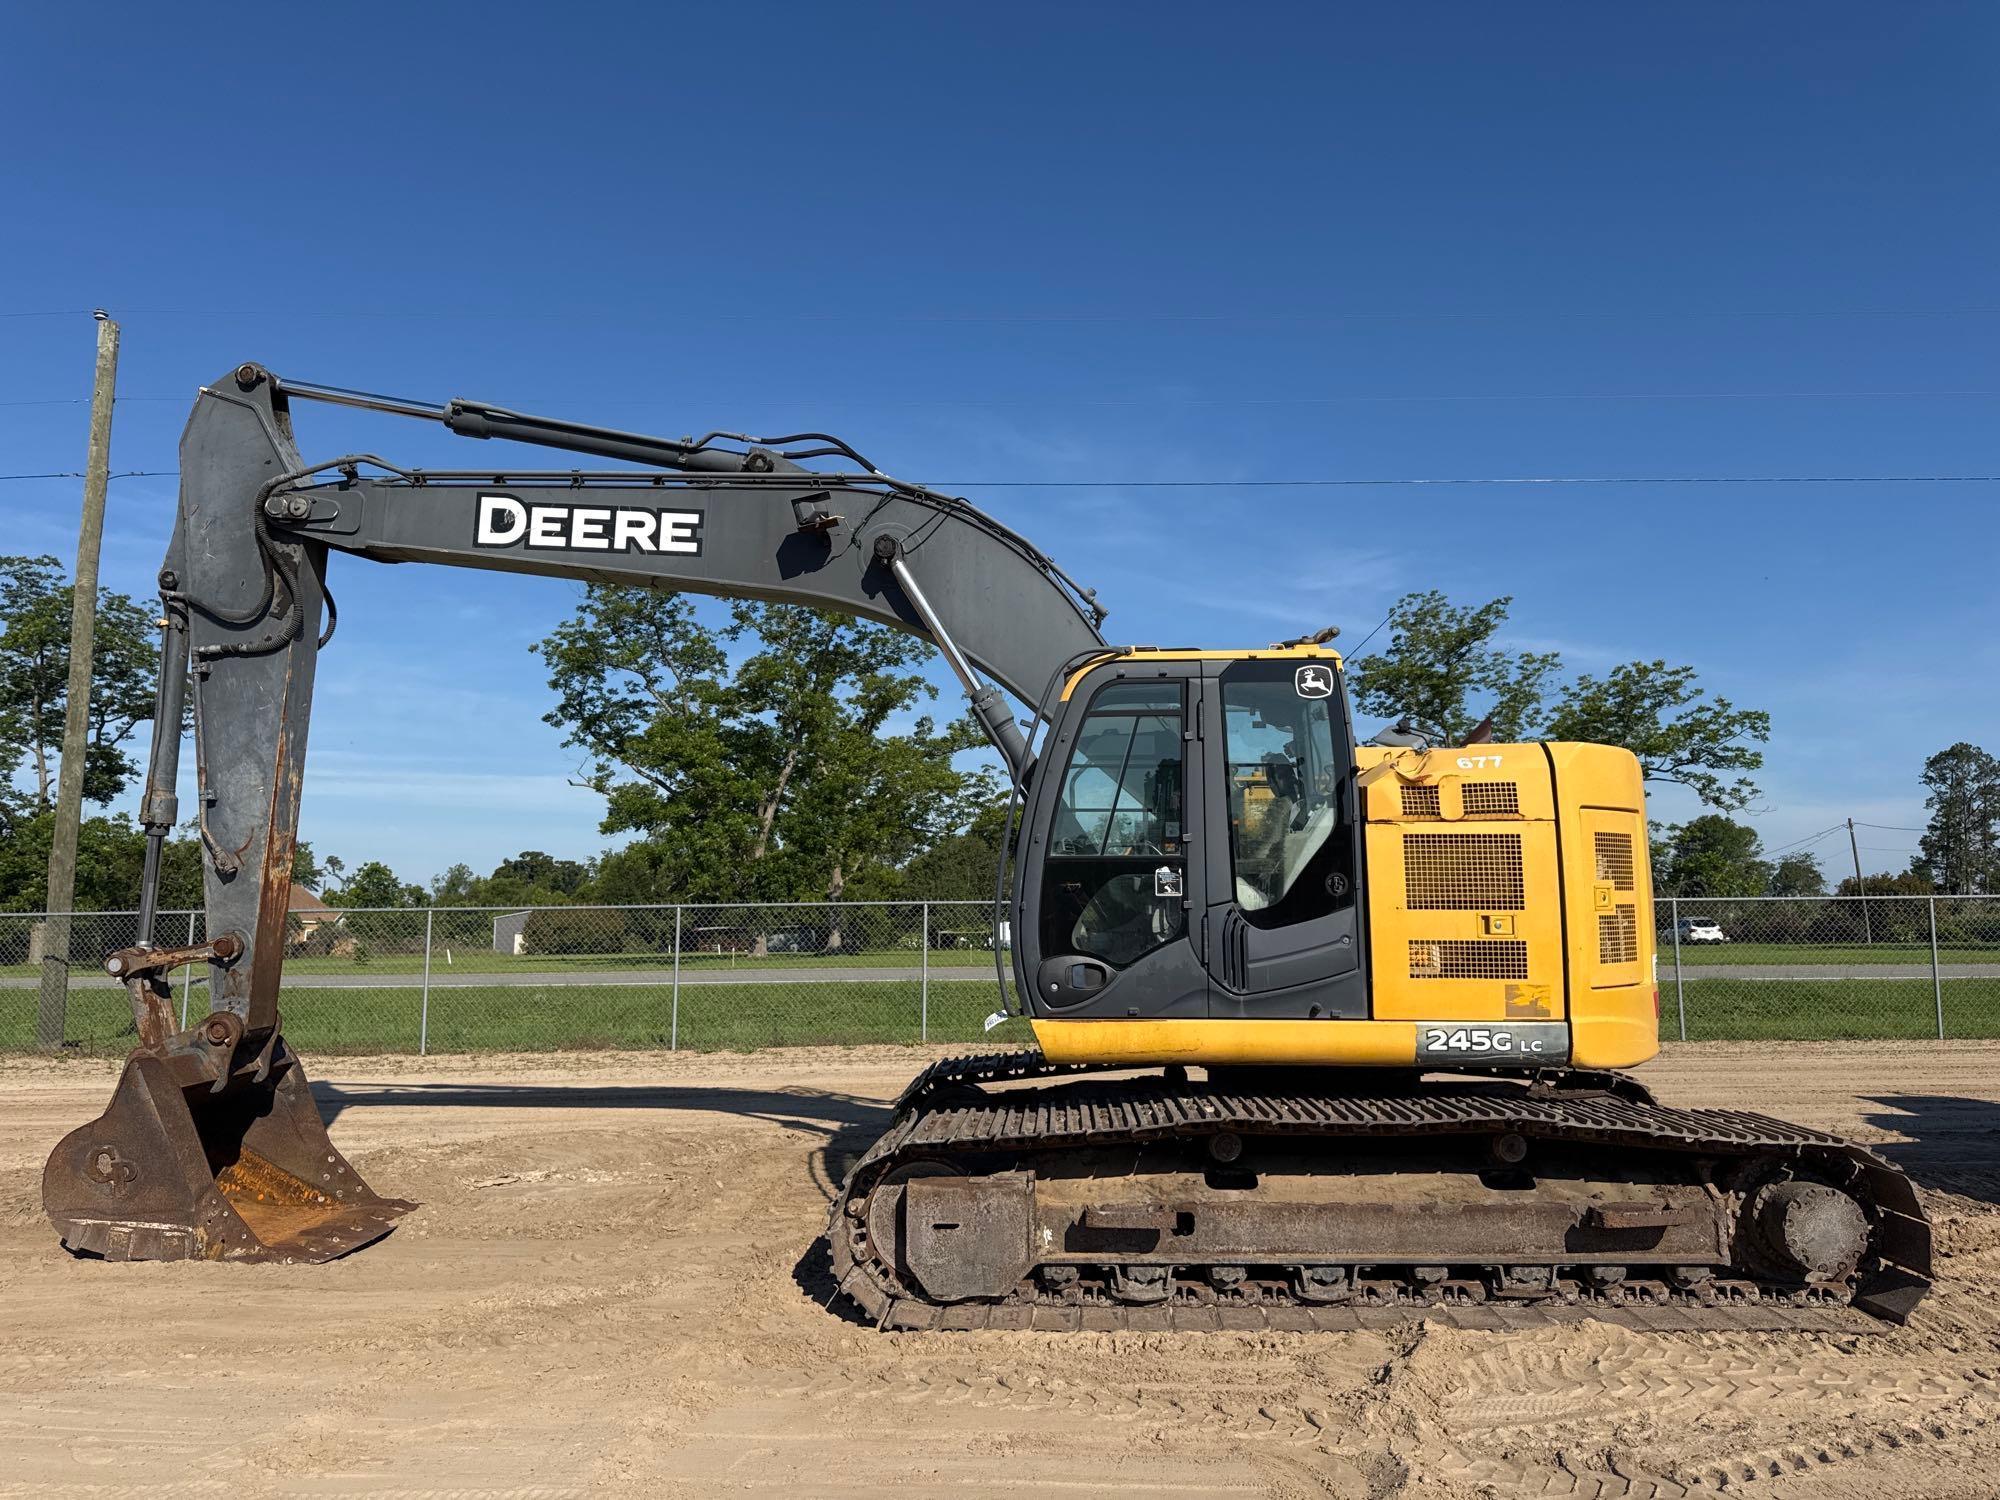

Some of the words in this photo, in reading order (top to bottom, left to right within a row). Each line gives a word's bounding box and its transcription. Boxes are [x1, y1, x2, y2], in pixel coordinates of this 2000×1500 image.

[477, 496, 701, 553] DEERE
[1456, 755, 1503, 769] 677
[1426, 1029, 1512, 1051] 245G
[1520, 1040, 1543, 1052] LC
